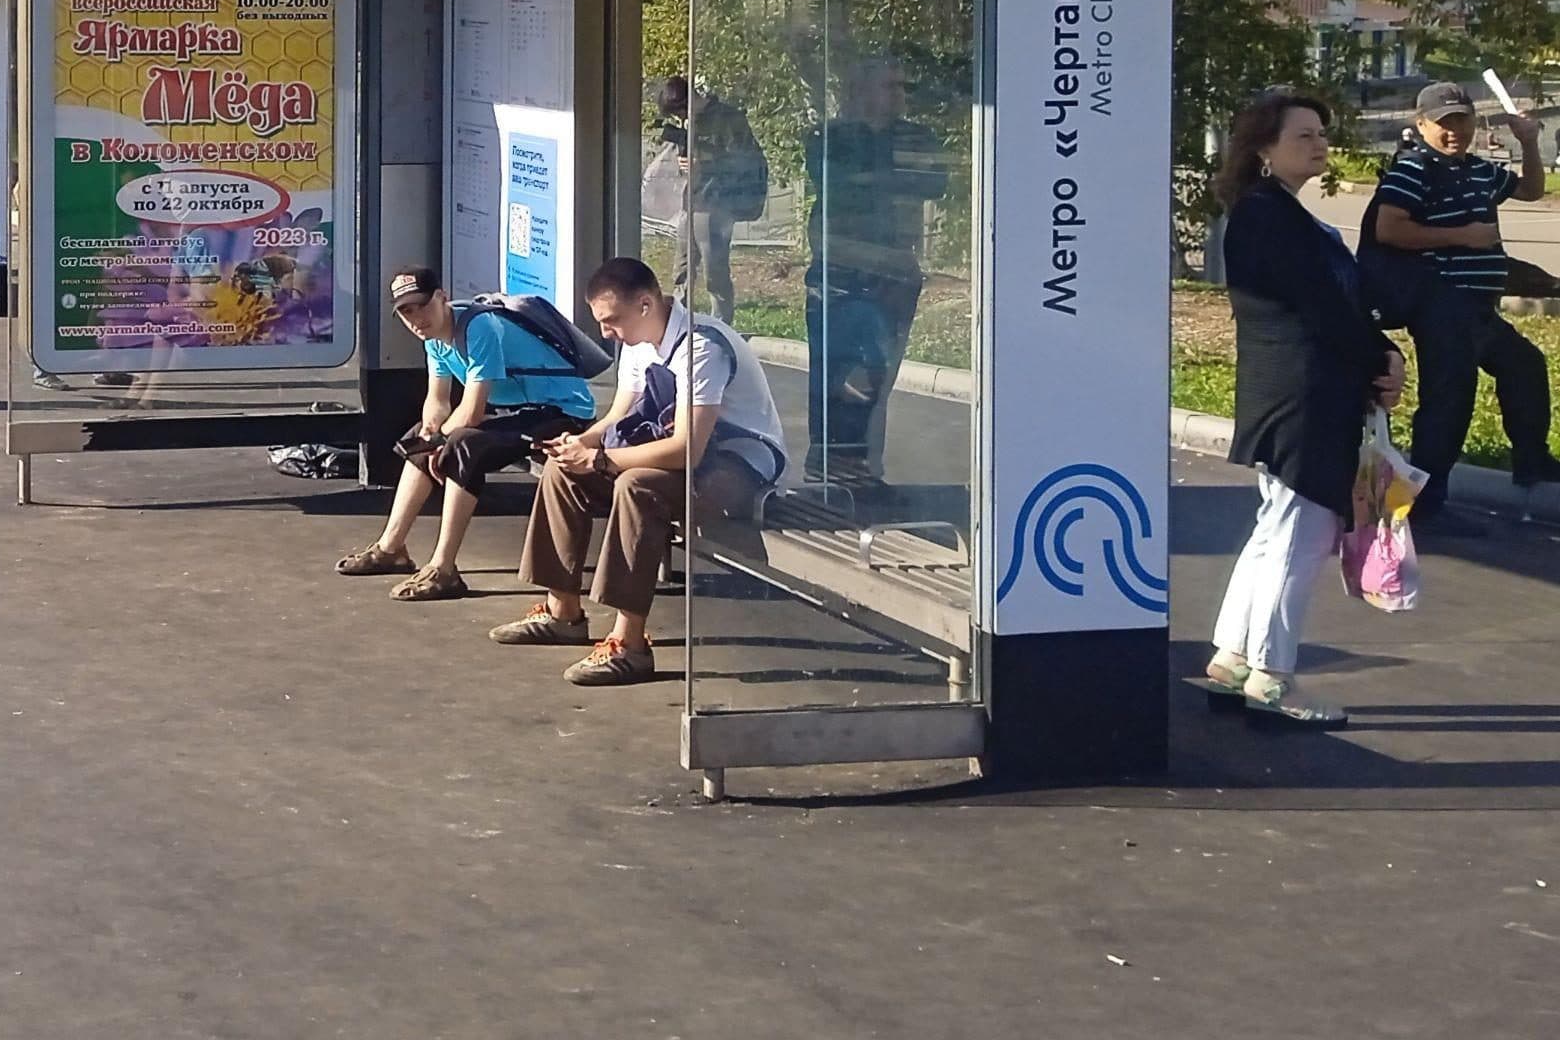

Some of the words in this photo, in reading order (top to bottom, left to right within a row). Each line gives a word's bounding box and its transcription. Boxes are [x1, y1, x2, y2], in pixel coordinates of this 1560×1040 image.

[236, 11, 258, 20] без
[262, 12, 328, 22] выходных
[75, 20, 241, 61] Ярмарка
[1089, 30, 1116, 117] Metro
[142, 66, 316, 134] Мёда
[71, 141, 90, 162] в
[100, 137, 317, 164] Коломенском
[142, 184, 151, 195] с
[179, 183, 250, 199] августа
[134, 199, 156, 211] по
[162, 197, 182, 210] 22
[188, 197, 265, 213] октября
[60, 235, 145, 249] бесплатный
[149, 235, 204, 249] автобус
[254, 229, 305, 246] 2023
[309, 232, 328, 246] г.
[1042, 176, 1086, 317] Метро
[60, 256, 77, 267] от
[80, 256, 123, 268] метро
[125, 254, 219, 266] Коломенская
[58, 322, 235, 337] www.yarmarka-meda.com
